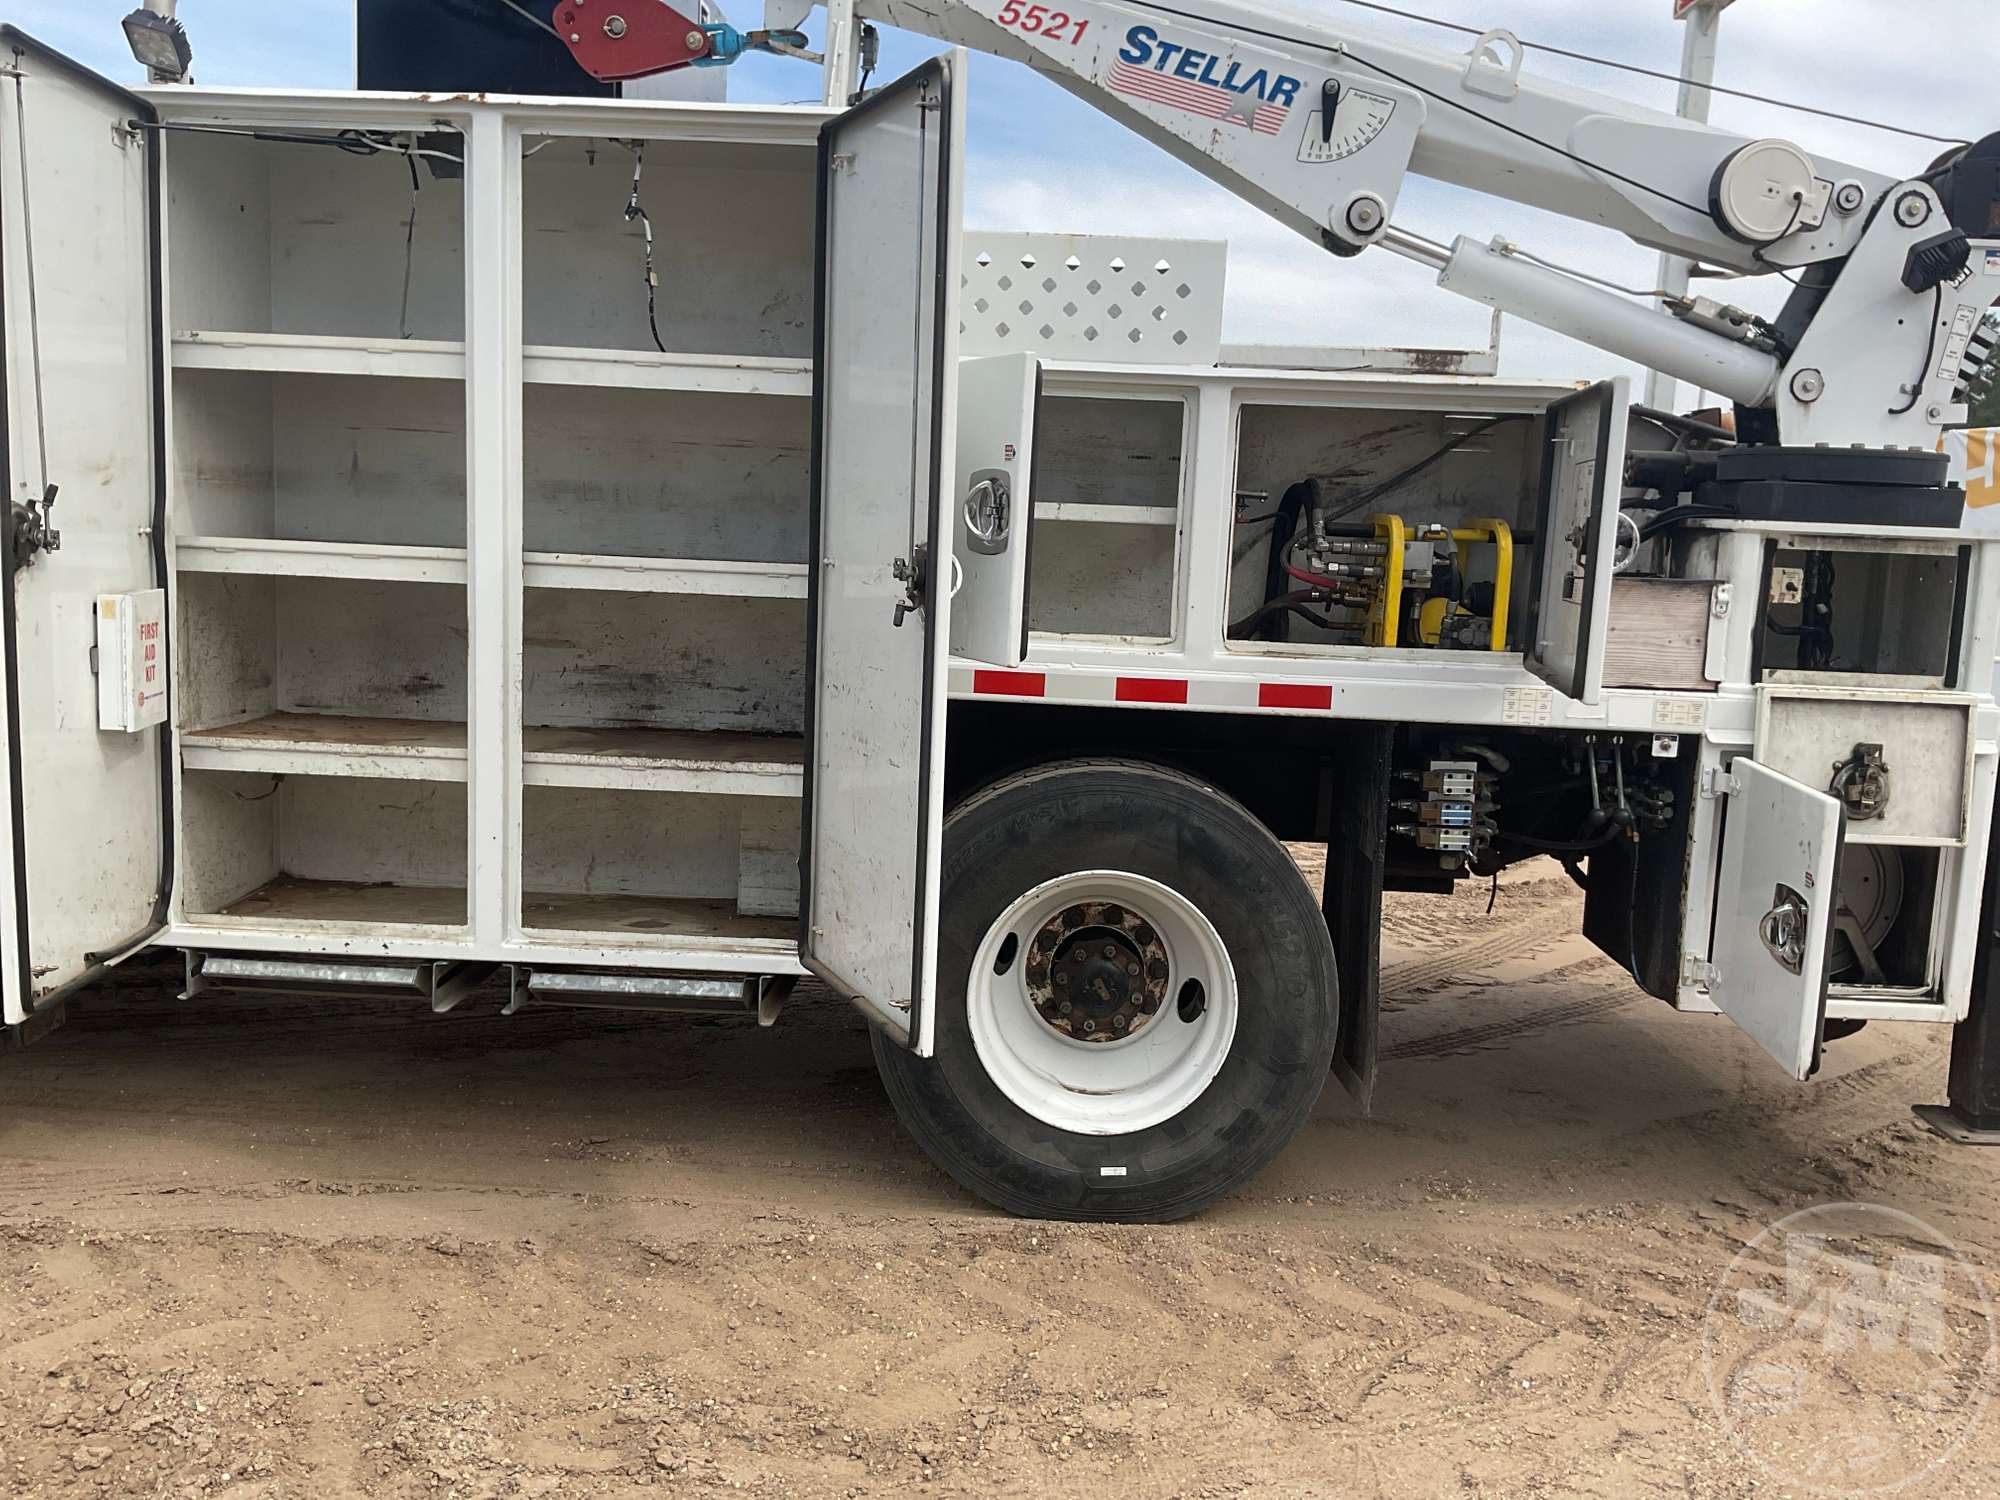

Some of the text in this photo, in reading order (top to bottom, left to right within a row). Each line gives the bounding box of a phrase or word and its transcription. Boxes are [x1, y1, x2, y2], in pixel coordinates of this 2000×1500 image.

[998, 0, 1090, 46] 5521
[1119, 26, 1301, 108] STELLAR
[140, 622, 159, 641] FIRST
[144, 644, 156, 662] AID
[145, 665, 156, 682] KIT
